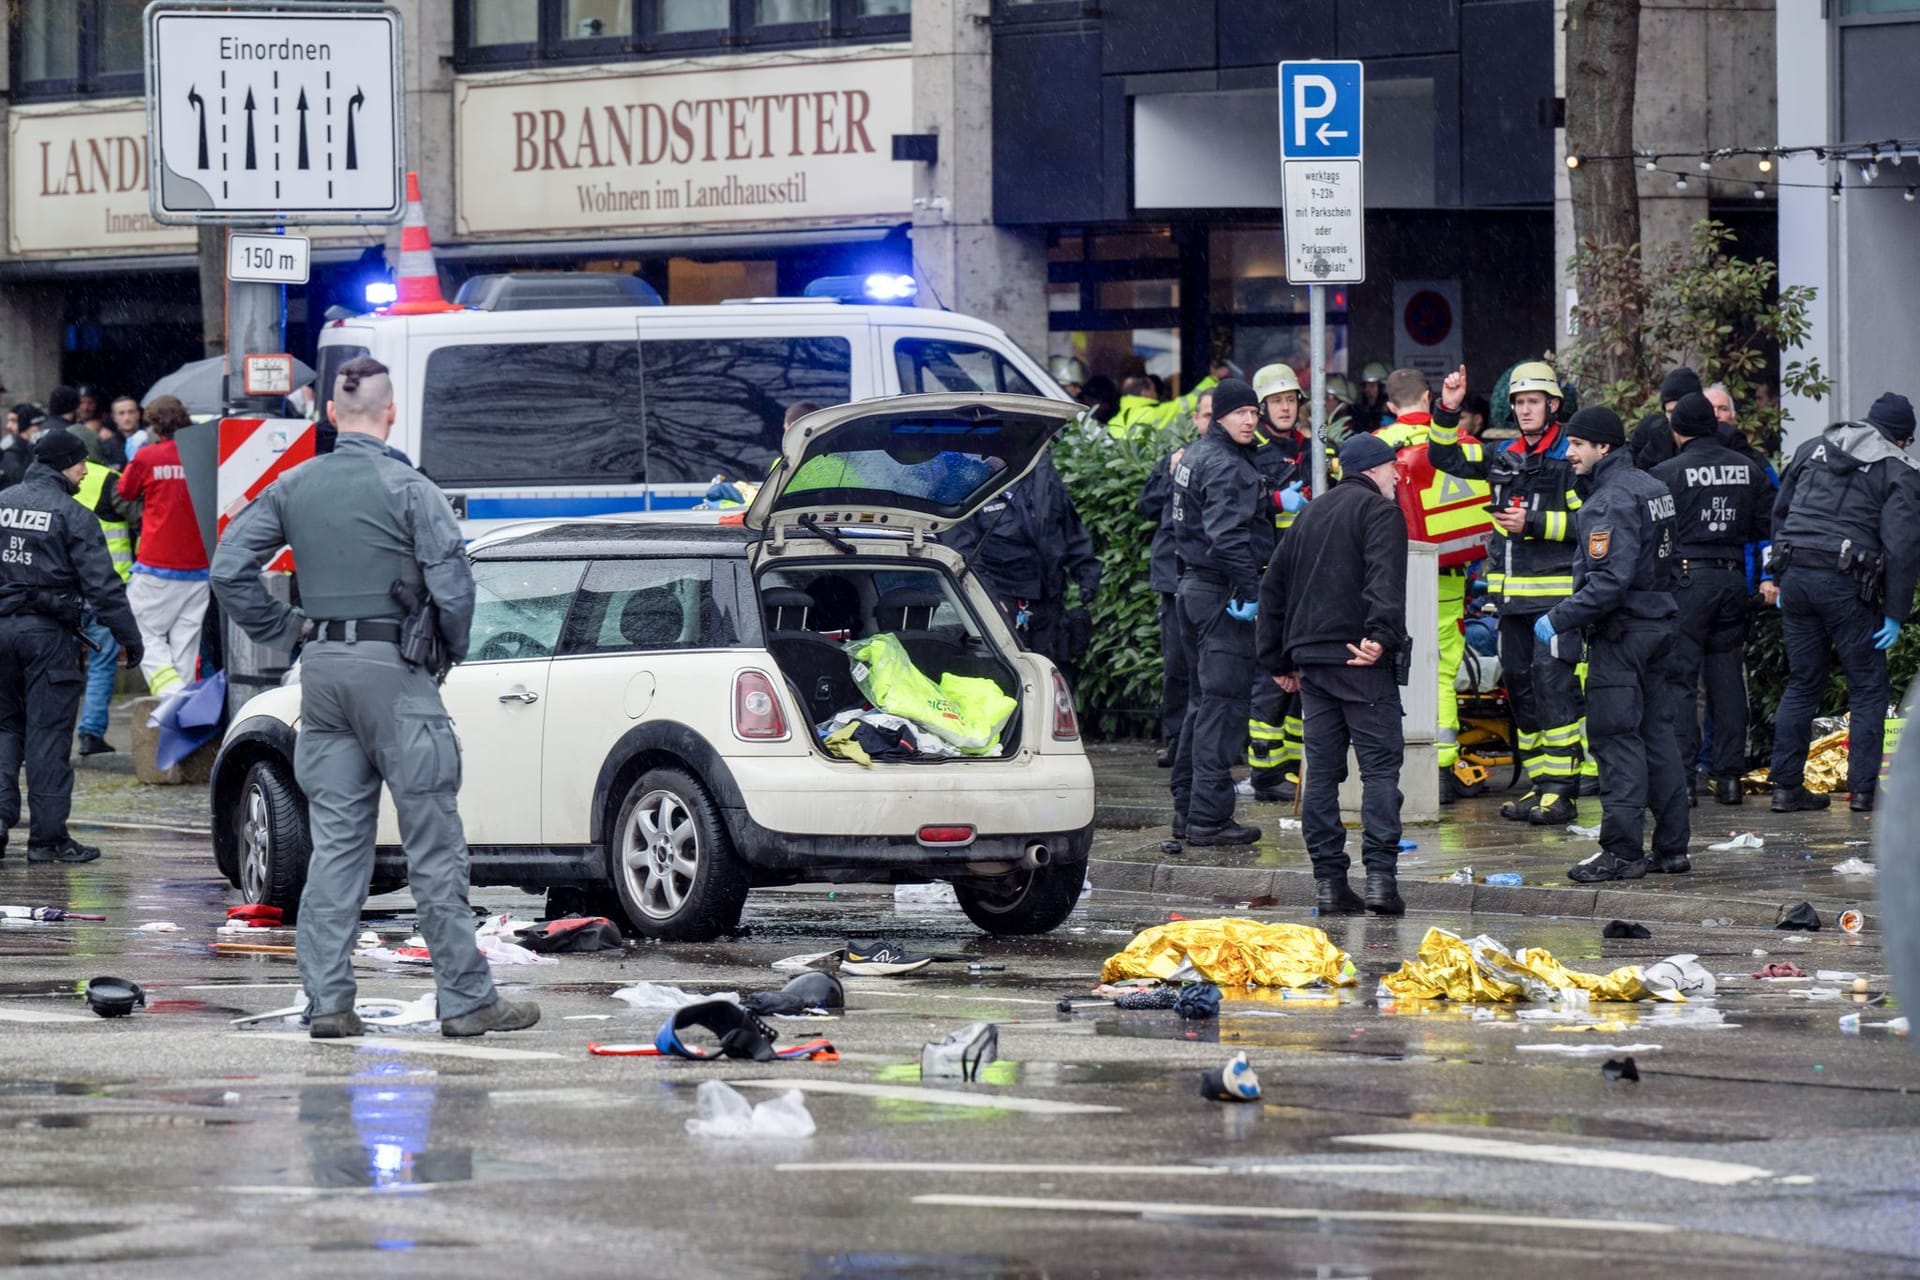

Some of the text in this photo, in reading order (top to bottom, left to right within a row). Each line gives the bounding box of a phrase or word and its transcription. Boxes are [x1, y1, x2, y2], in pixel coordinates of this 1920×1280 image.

[220, 36, 331, 61] Einordnen
[1293, 74, 1337, 146] P
[512, 88, 876, 173] BRANDSTETTER
[576, 171, 807, 213] Wohnen im Landhausstil
[1295, 206, 1352, 218] mit Parkschein
[1315, 225, 1332, 236] oder
[244, 246, 294, 271] 150 m
[1685, 464, 1751, 488] POLIZEI
[1711, 496, 1729, 509] BY
[0, 507, 53, 532] OLIZEI
[10, 535, 26, 551] BY
[2, 549, 33, 566] 6243
